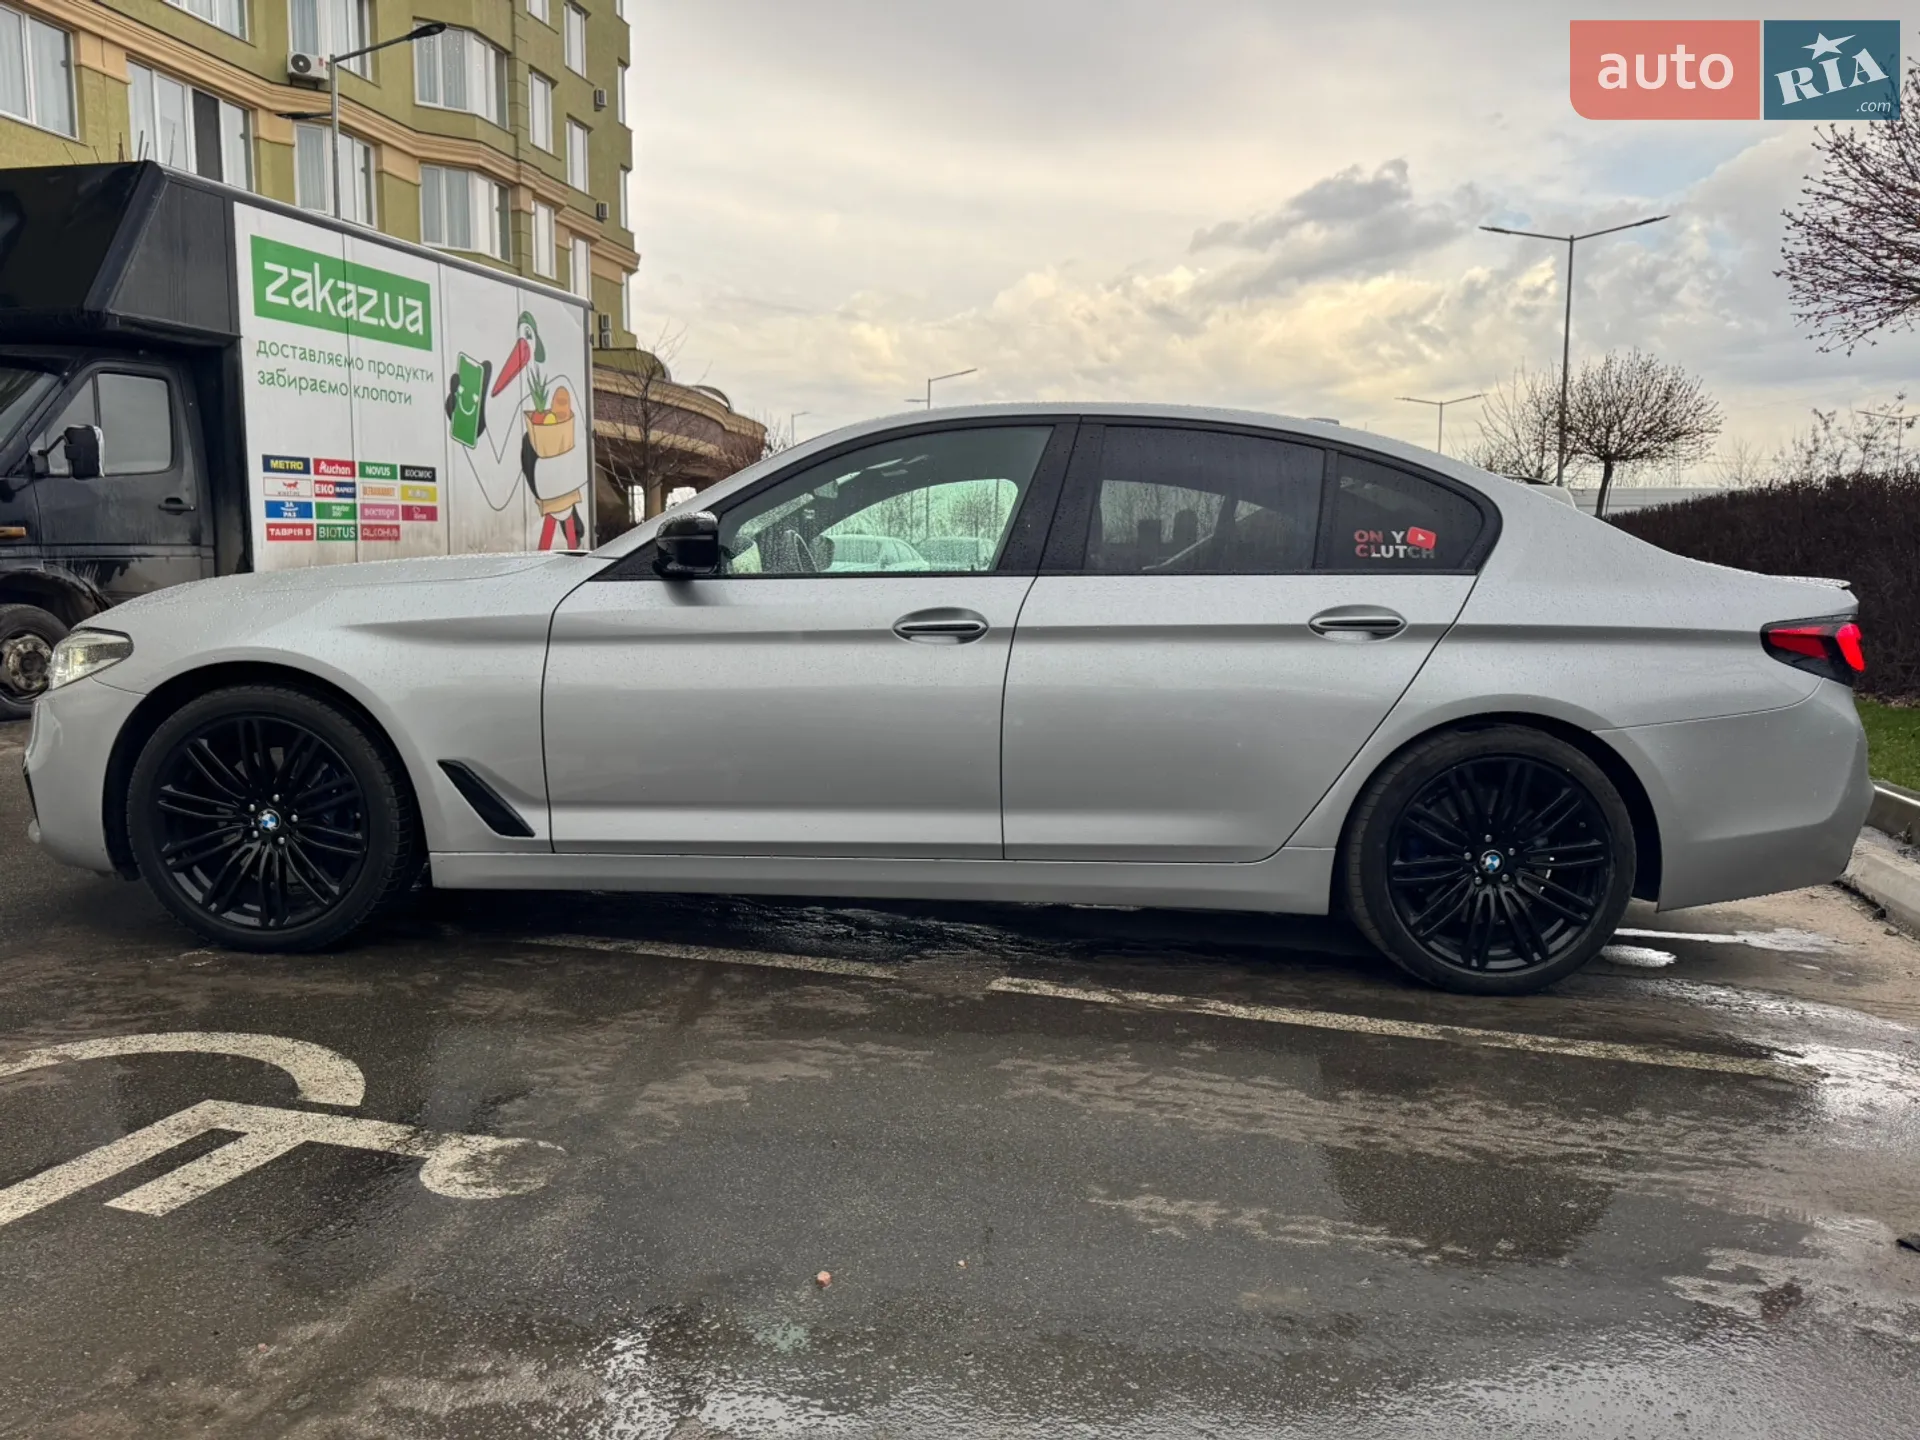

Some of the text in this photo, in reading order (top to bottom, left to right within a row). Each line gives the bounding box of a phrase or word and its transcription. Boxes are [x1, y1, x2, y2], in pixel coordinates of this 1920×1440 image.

[264, 261, 424, 336] zakaz.ua
[257, 339, 434, 383] доставляємо продукти
[258, 368, 412, 406] забираємо клопоти
[270, 459, 304, 470] METRO
[319, 461, 350, 475] Auchan
[366, 465, 390, 476] NOVUS
[405, 469, 433, 479] КОСМОС
[319, 526, 355, 538] BIOTUS
[1354, 530, 1384, 543] ON
[1355, 544, 1435, 559] CLUTCH
